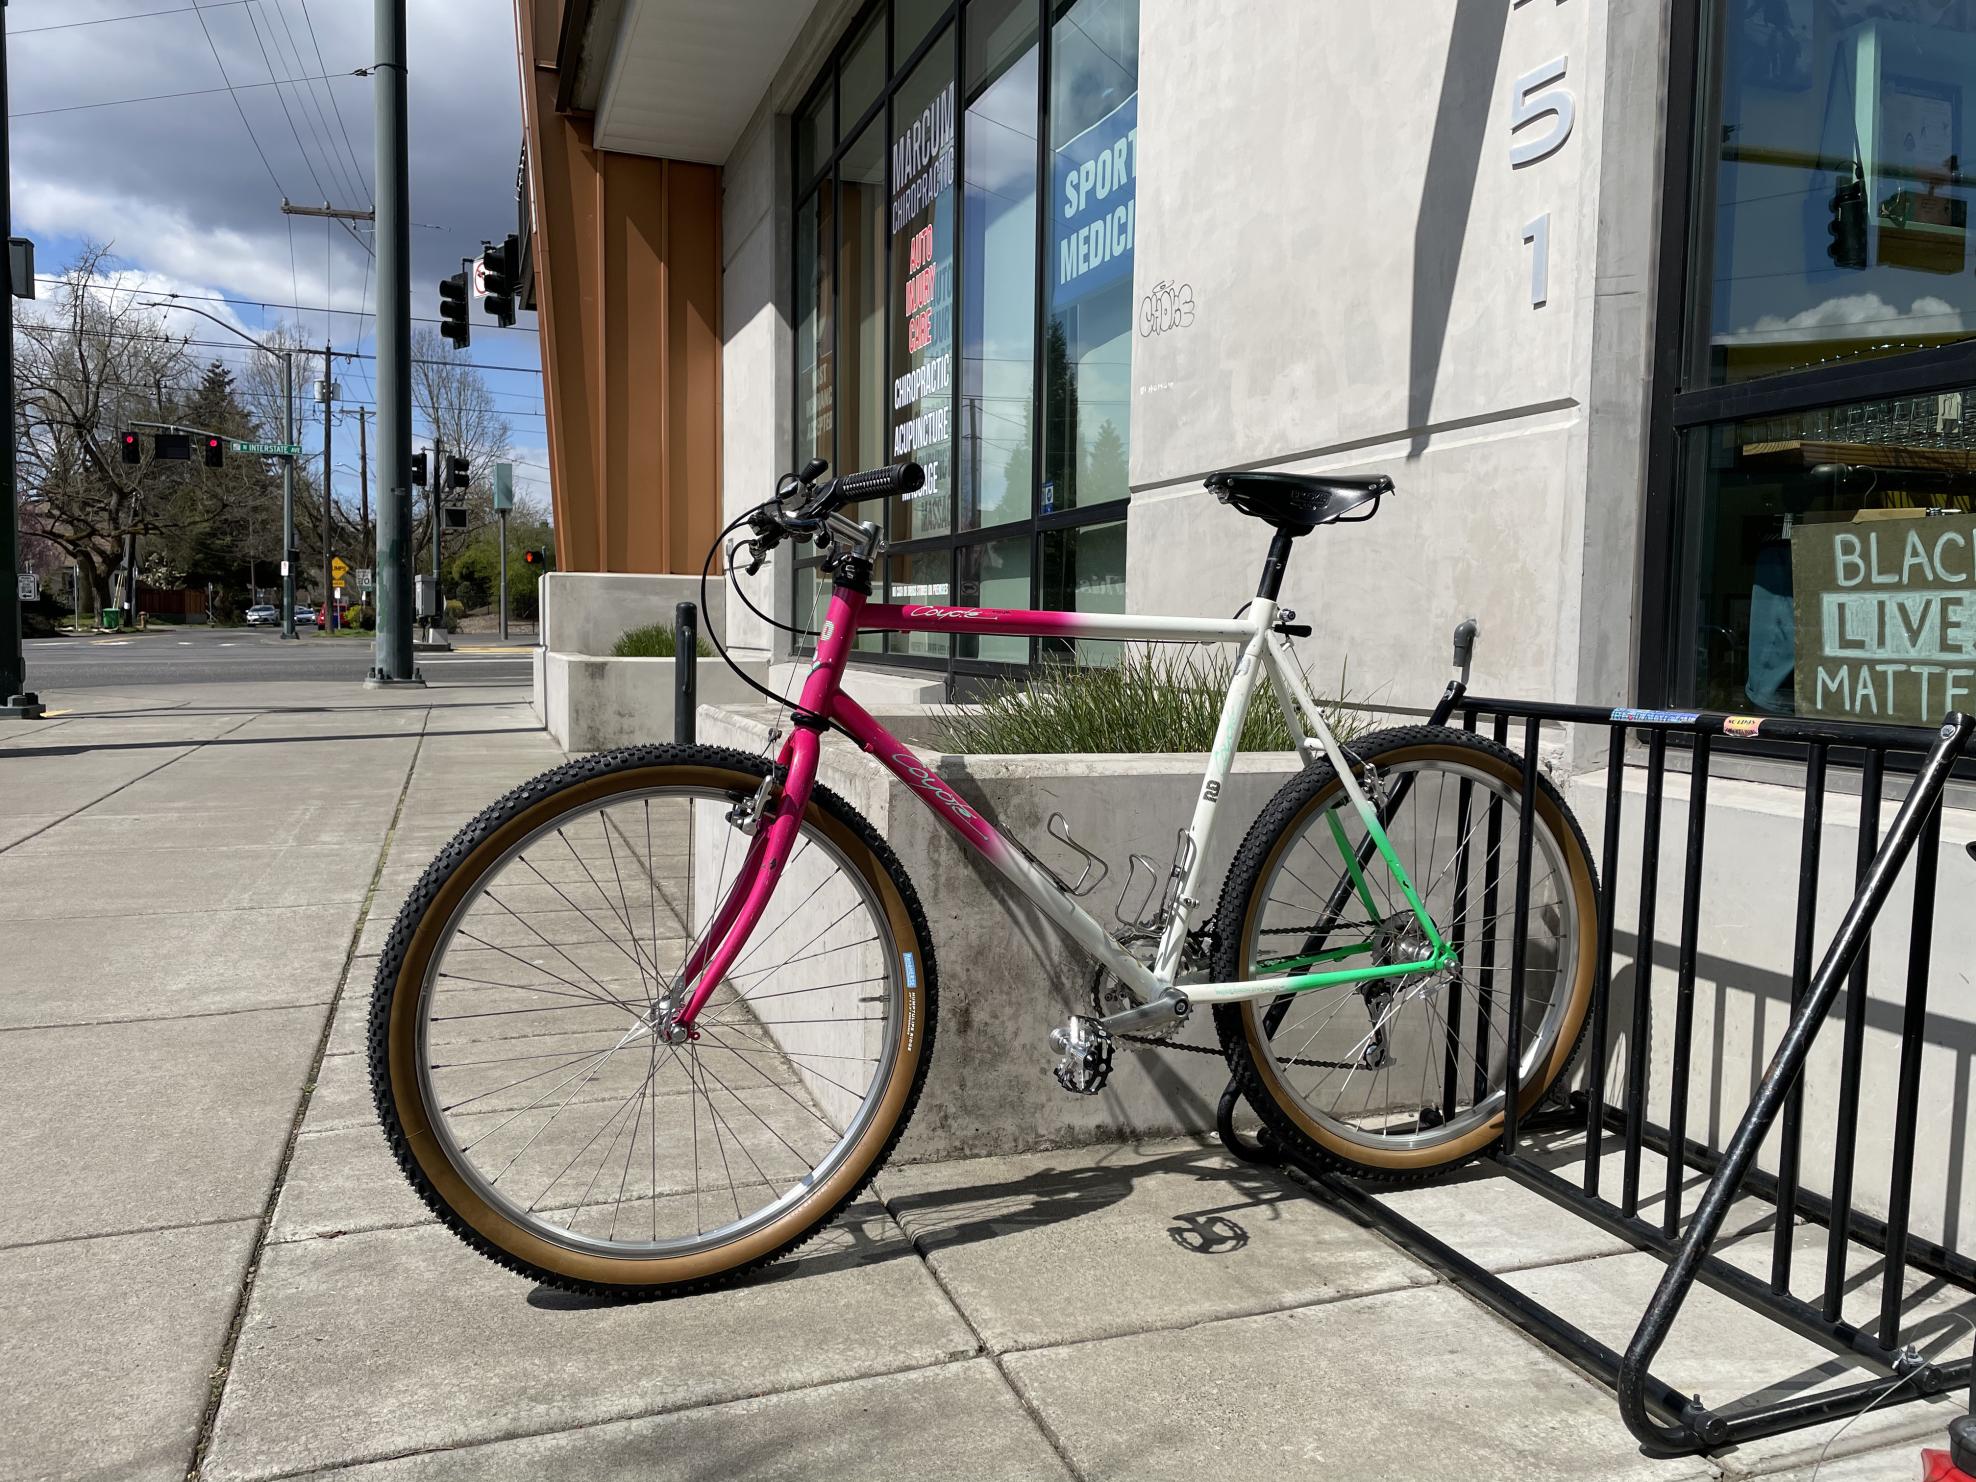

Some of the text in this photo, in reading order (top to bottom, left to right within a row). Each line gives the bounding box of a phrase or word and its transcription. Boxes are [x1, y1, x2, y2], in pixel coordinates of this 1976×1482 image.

[892, 80, 954, 196] MARCUM
[892, 146, 954, 235] CHIROPRACTIC
[1064, 127, 1137, 219] SPORT
[909, 223, 933, 275] AUTO
[1060, 199, 1135, 285] MEDICI
[908, 306, 932, 353] CARE
[894, 353, 950, 410] CHIROPRACTIC
[249, 444, 288, 454] INTERSTATE
[893, 405, 949, 457] ACUPUNCTURE
[1834, 528, 1976, 587] BLAC
[1836, 596, 1976, 653] LIVE
[892, 753, 989, 840] Coyote
